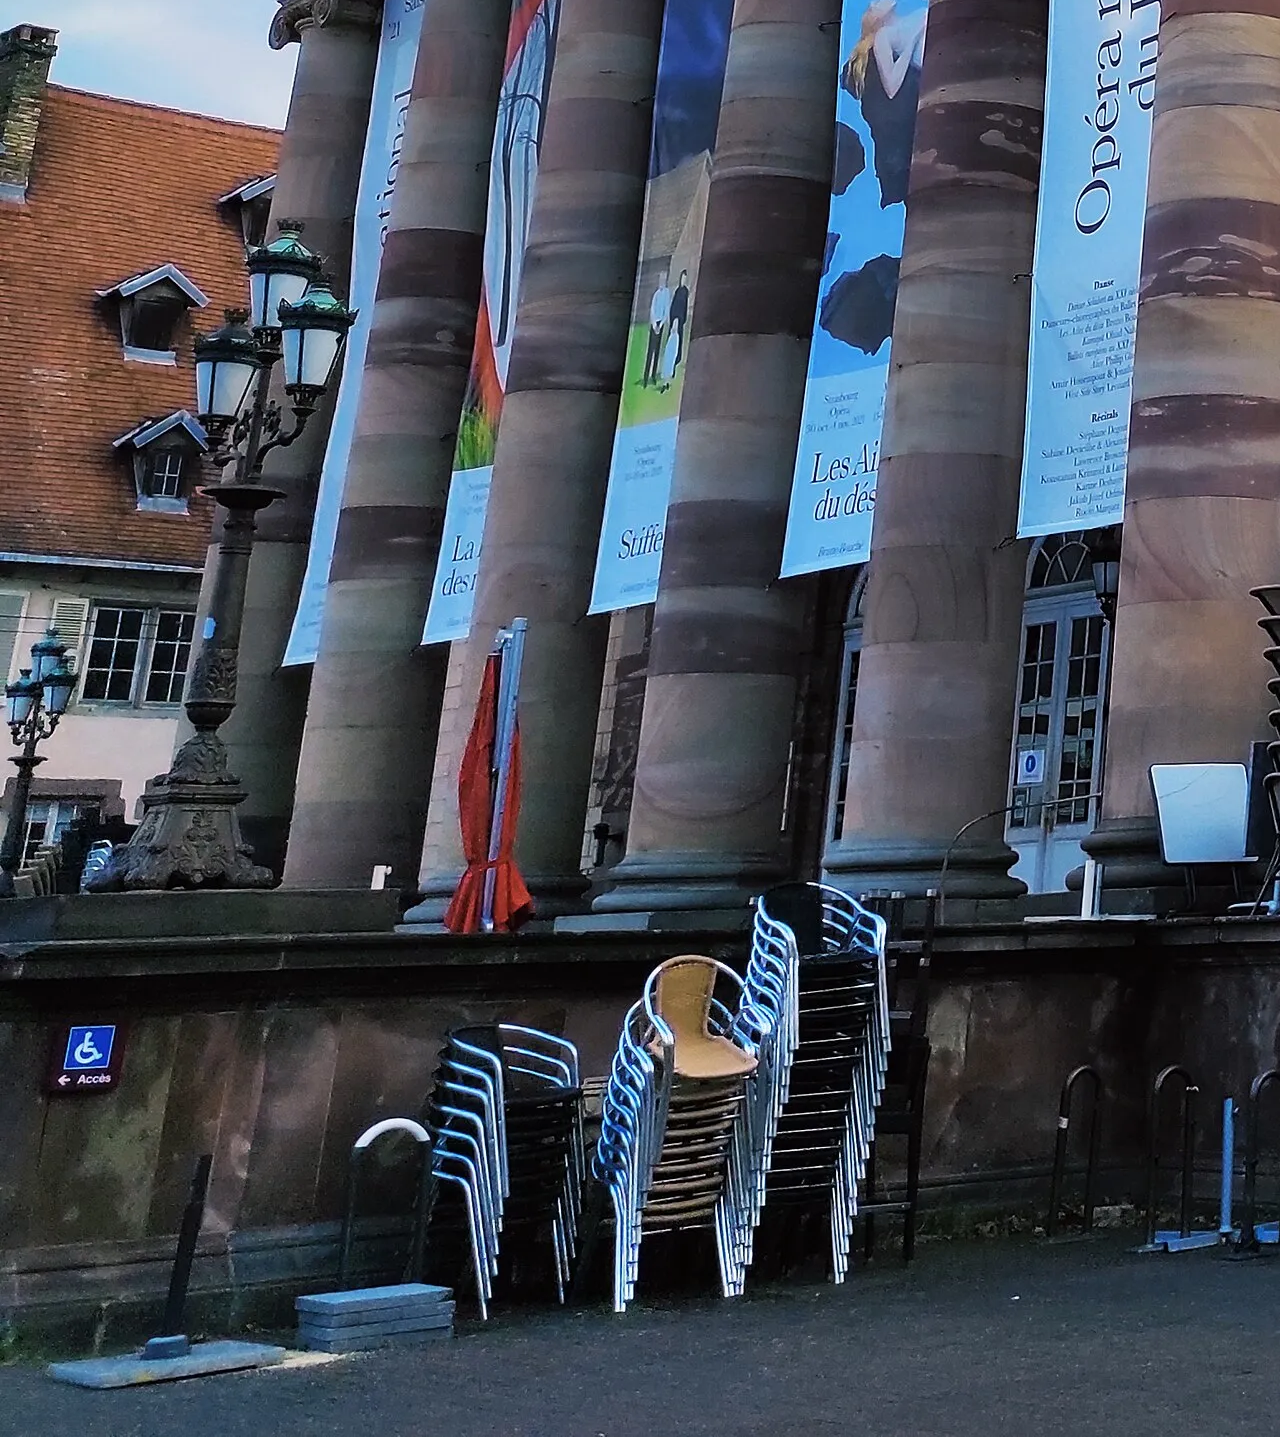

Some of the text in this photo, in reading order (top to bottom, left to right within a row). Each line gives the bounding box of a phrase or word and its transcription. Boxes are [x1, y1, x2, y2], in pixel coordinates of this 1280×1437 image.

[1128, 34, 1160, 111] du
[1075, 29, 1122, 235] Opéra
[811, 441, 879, 484] Les Ai
[814, 489, 840, 521] du
[452, 535, 474, 562] La
[442, 569, 468, 596] des
[77, 1073, 112, 1085] Accès
